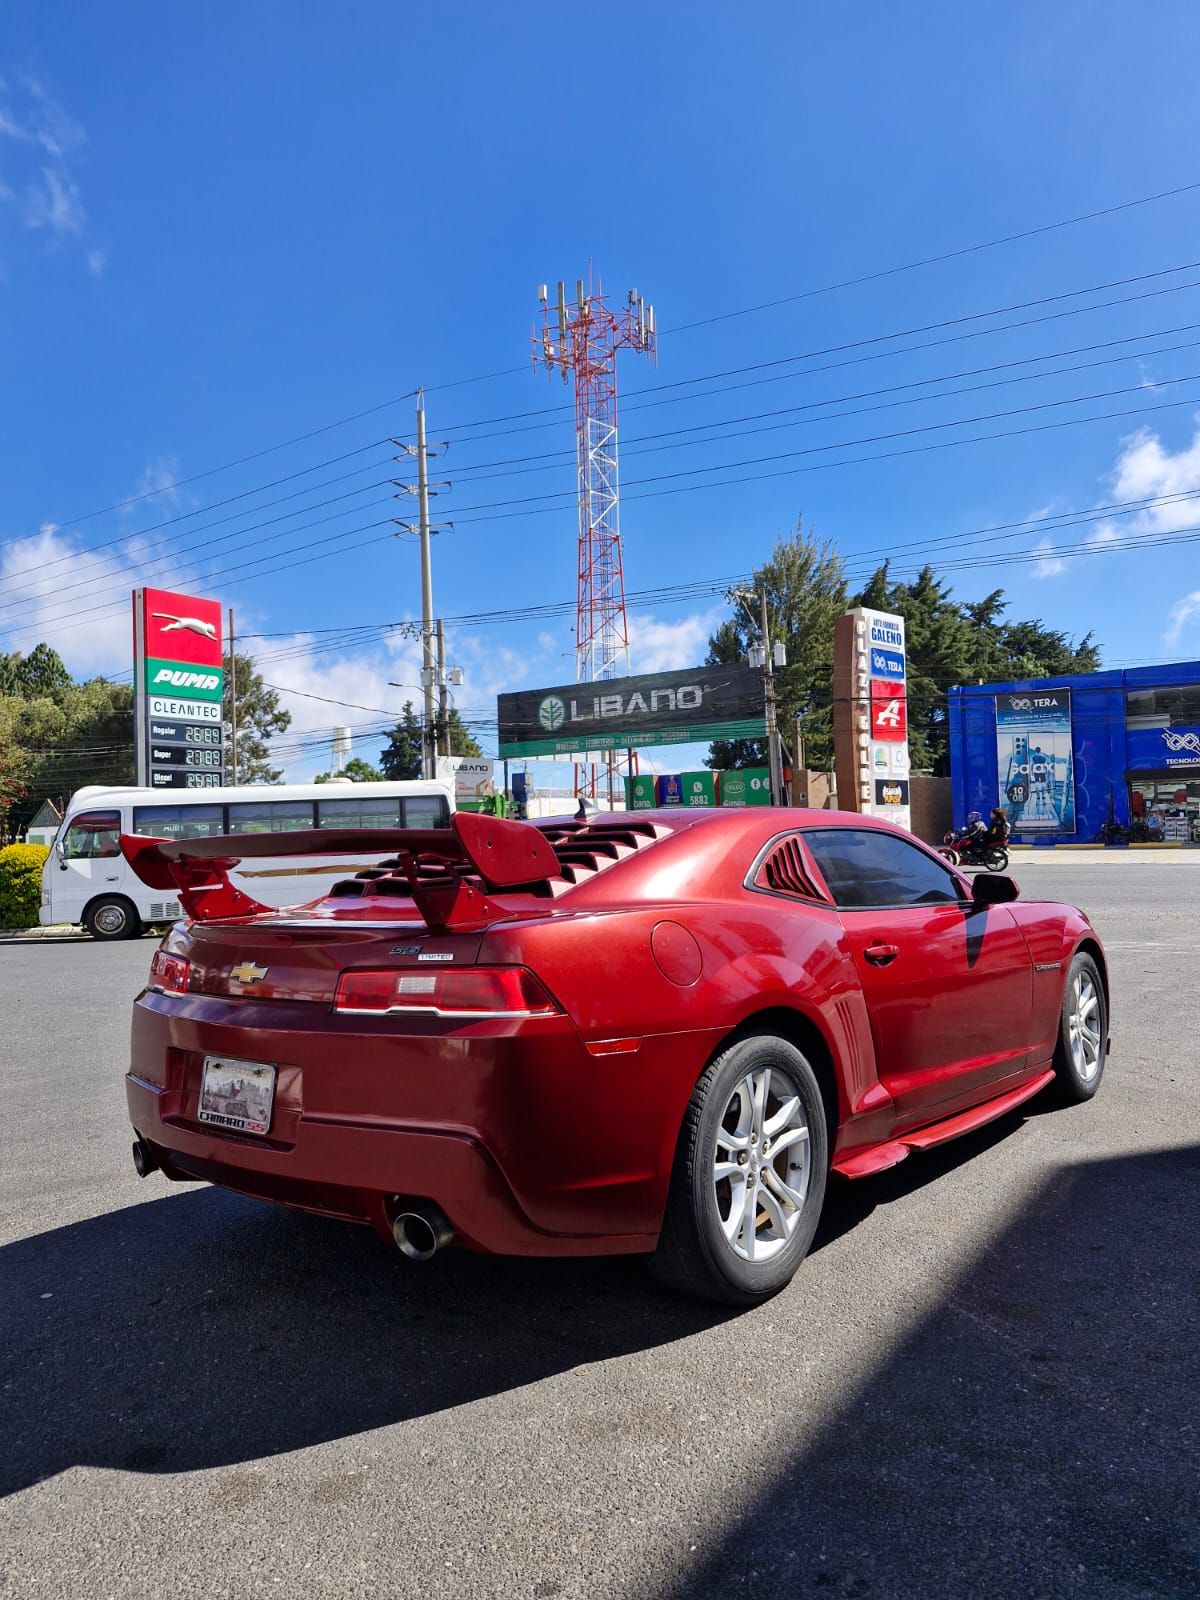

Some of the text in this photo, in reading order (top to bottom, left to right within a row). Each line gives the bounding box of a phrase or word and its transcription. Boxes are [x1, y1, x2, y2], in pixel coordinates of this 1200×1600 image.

[871, 627, 902, 646] GALENO
[887, 660, 903, 673] TERA
[153, 669, 220, 690] PUMA
[154, 701, 218, 718] CLEANTEC
[570, 685, 703, 721] LIBANO
[1033, 698, 1058, 707] TERA
[153, 726, 176, 735] Regular
[154, 750, 171, 759] Super
[453, 764, 488, 772] LIBANO
[200, 1111, 265, 1132] CAMARO SS
